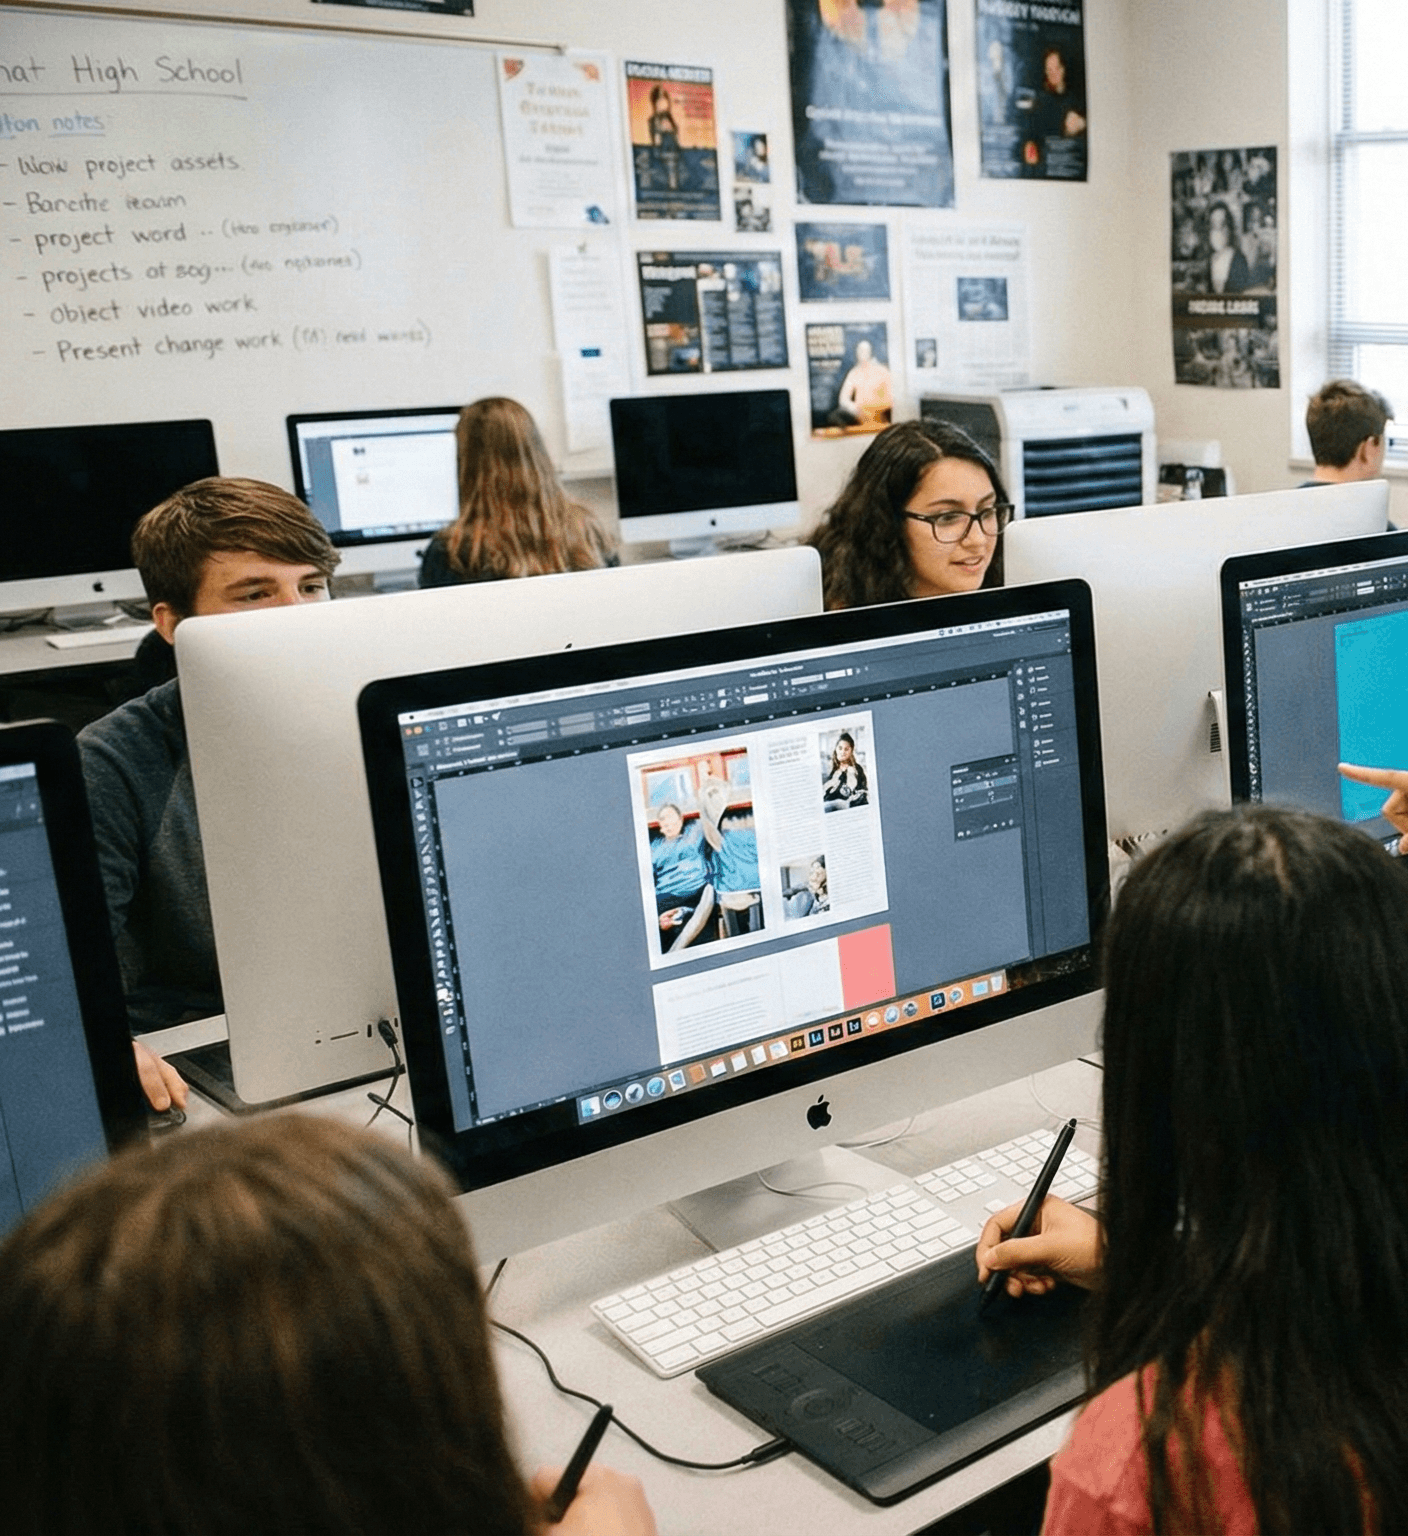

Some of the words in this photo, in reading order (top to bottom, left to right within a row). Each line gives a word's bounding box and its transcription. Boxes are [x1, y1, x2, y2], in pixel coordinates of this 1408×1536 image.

[71, 54, 139, 94] High
[155, 55, 243, 84] School
[86, 154, 156, 180] project
[35, 223, 115, 255] project
[132, 225, 187, 244] word
[42, 262, 133, 293] projects
[137, 297, 193, 318] video
[205, 293, 258, 314] work
[57, 337, 142, 363] Present
[154, 334, 225, 360] change
[235, 331, 284, 350] work
